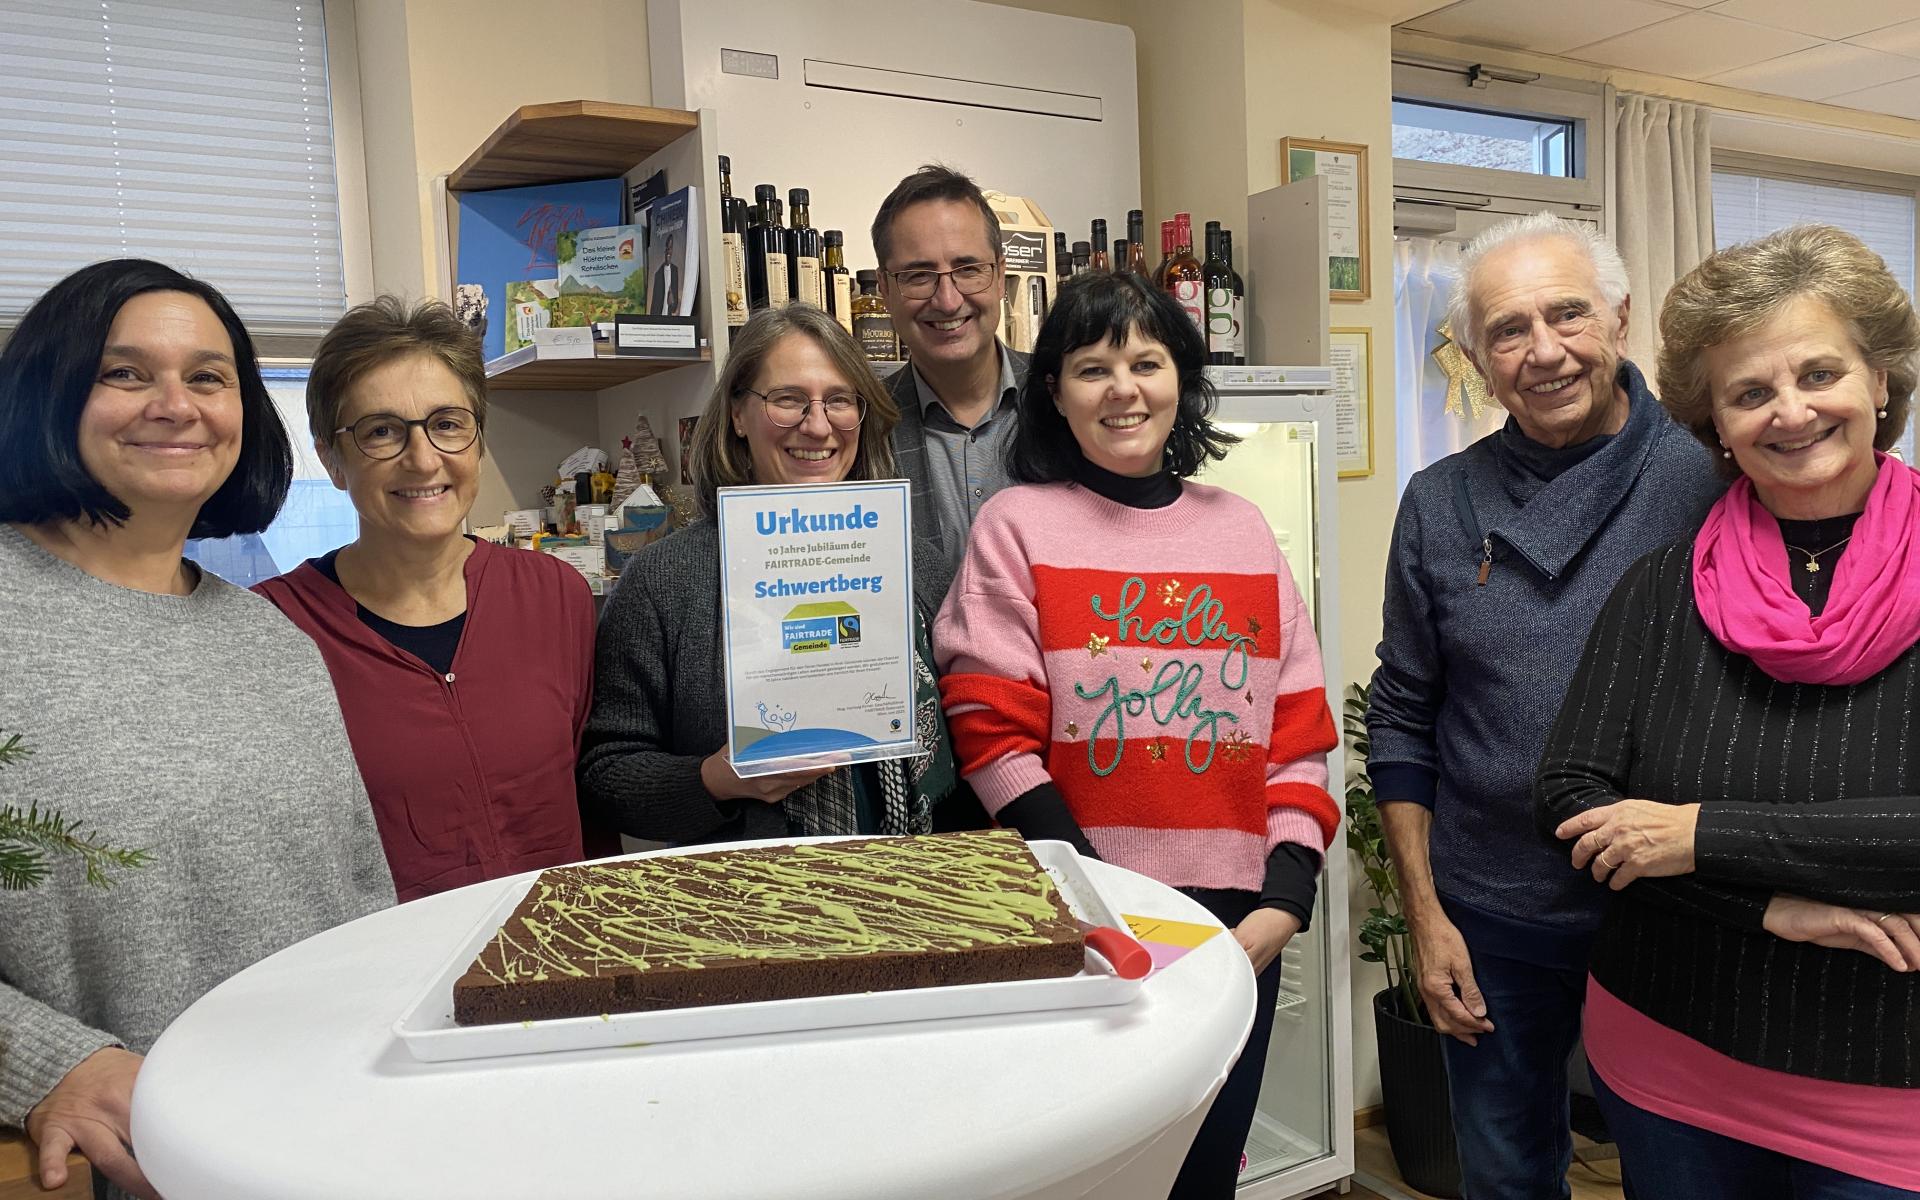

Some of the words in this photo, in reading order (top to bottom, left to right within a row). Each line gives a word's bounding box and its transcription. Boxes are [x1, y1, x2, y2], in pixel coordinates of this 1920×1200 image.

[582, 247, 596, 255] Das
[756, 504, 879, 536] Urkunde
[768, 548, 779, 556] 10
[780, 544, 806, 556] Jahre
[807, 541, 850, 554] Jubiläum
[851, 540, 867, 549] der
[765, 554, 872, 570] FAIRTRADE-Gemeinde
[754, 573, 883, 599] Schwertberg
[784, 628, 833, 640] FAIRTRADE
[1091, 577, 1259, 690] holly
[793, 642, 828, 651] Gemeinde
